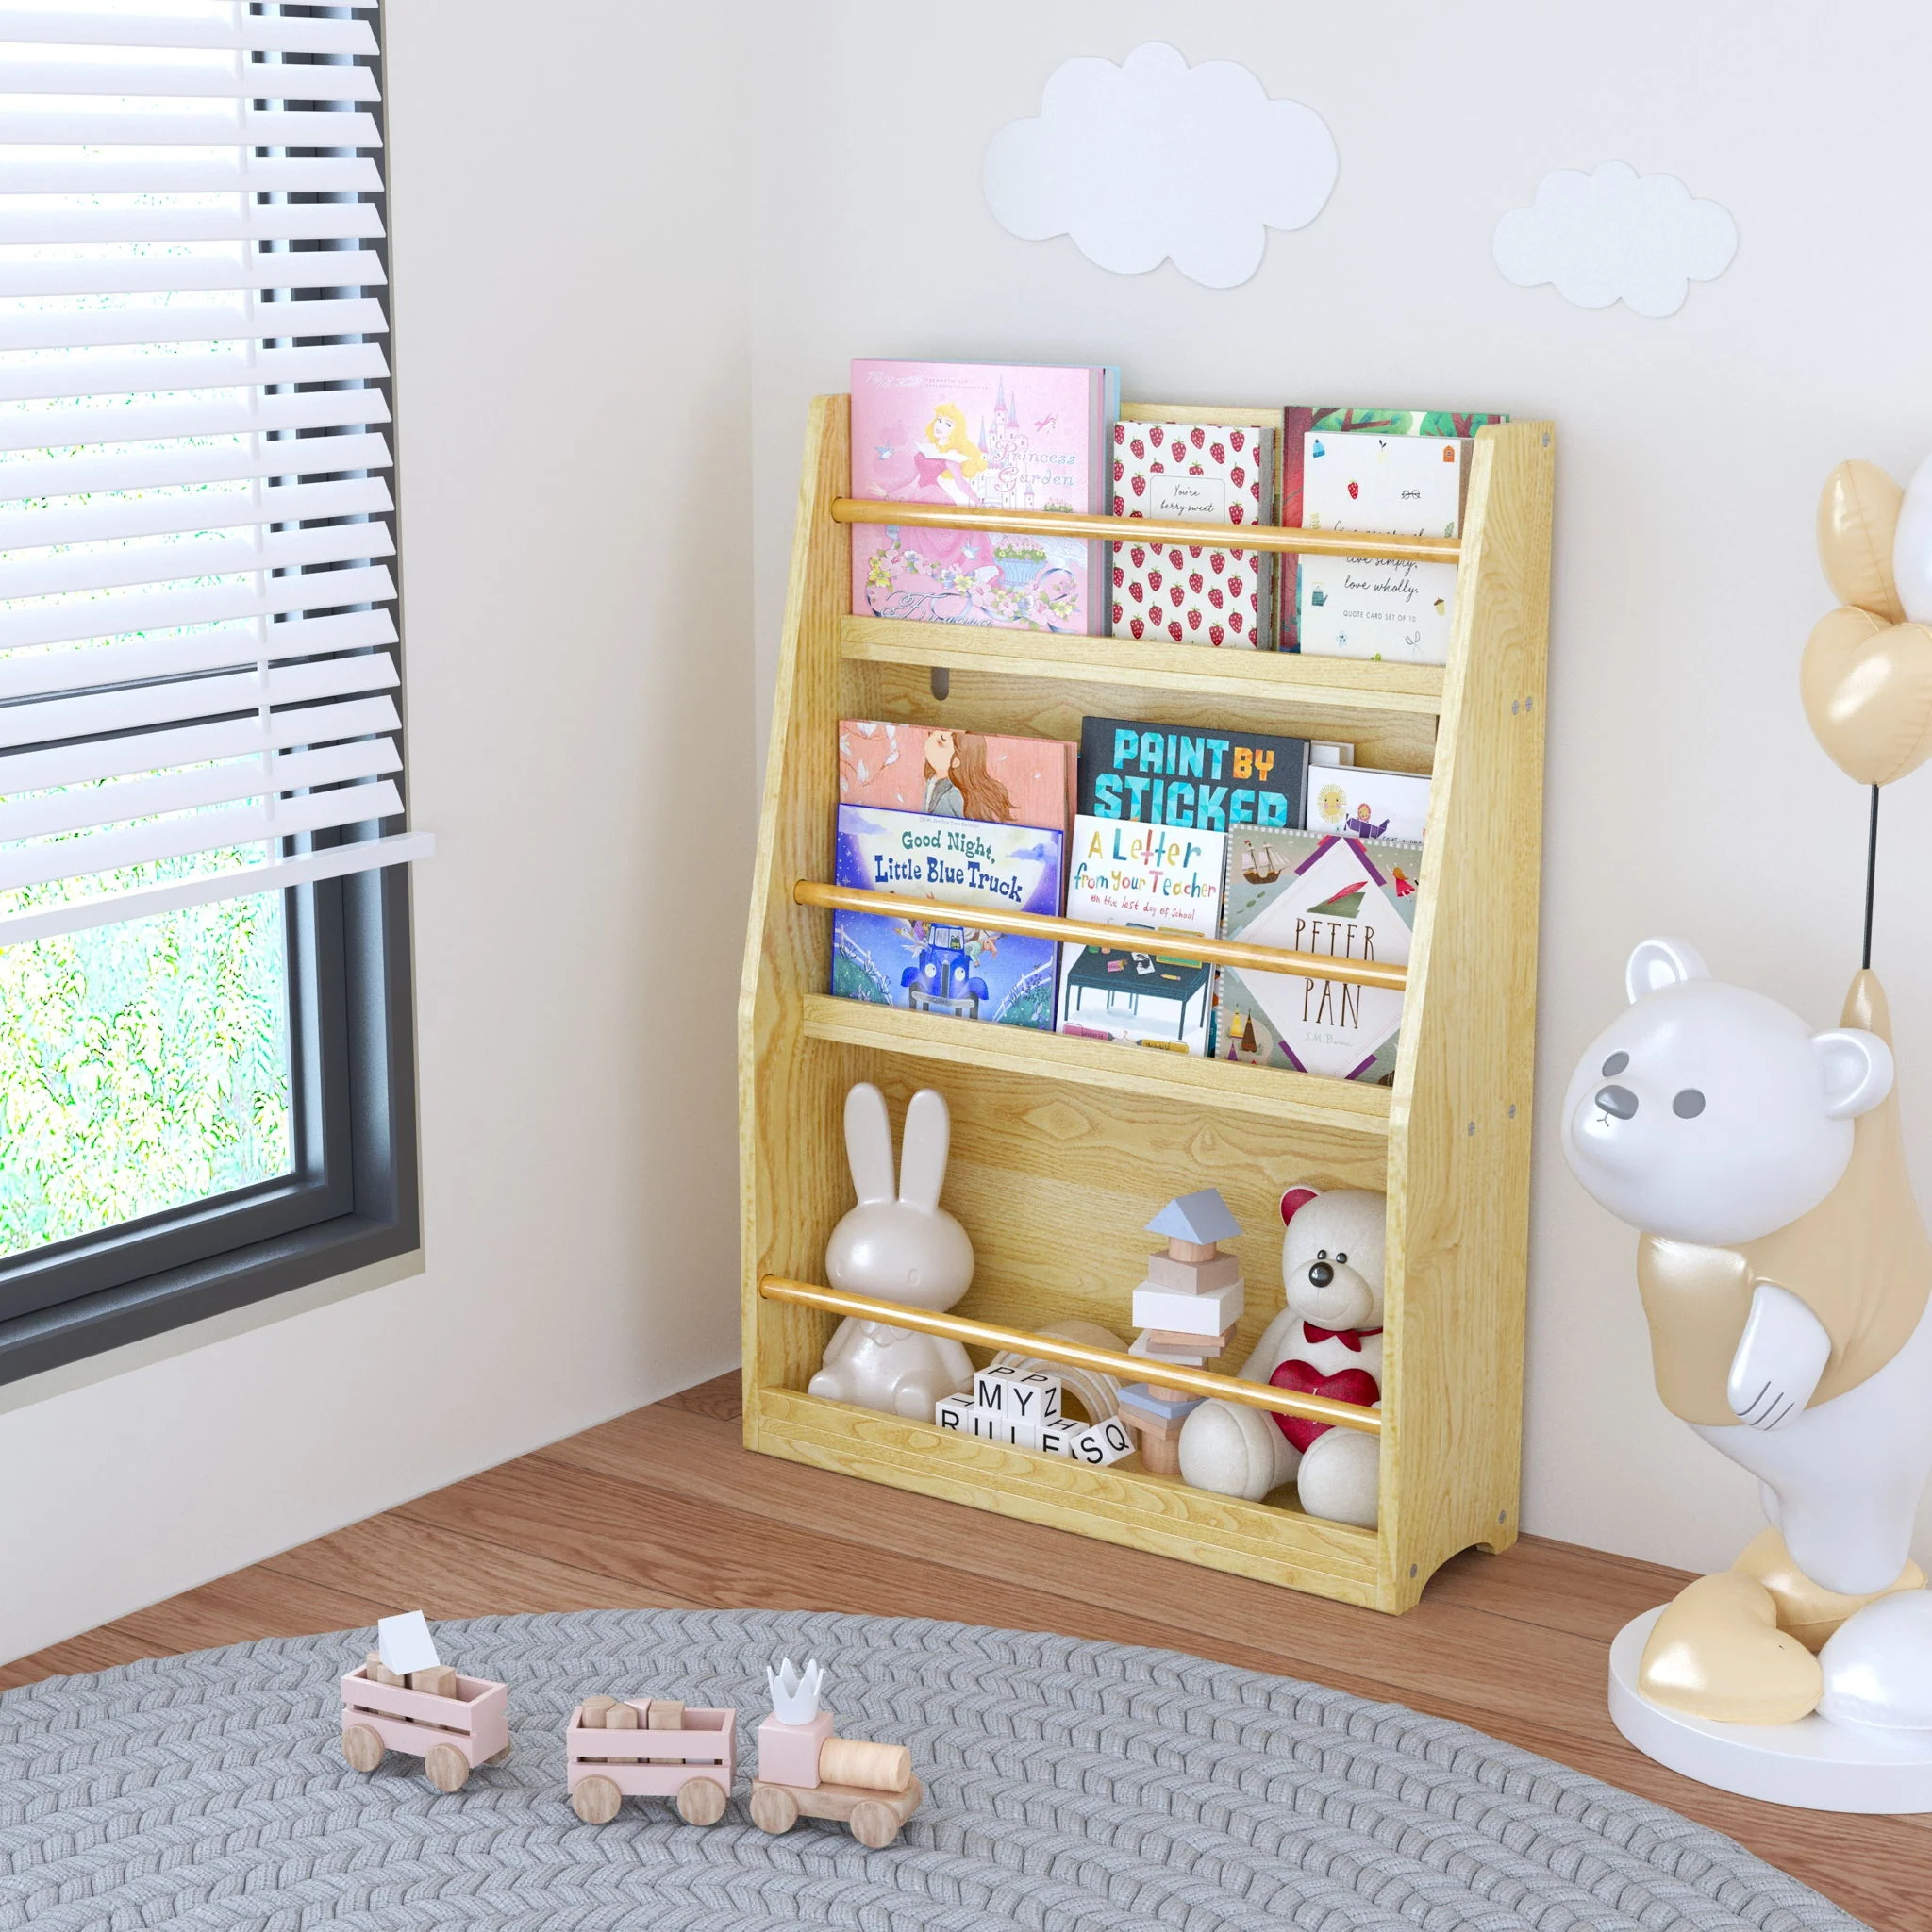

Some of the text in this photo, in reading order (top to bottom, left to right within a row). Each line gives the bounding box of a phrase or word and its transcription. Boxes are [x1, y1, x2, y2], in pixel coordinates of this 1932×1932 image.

[993, 440, 1076, 465] Princess
[994, 467, 1074, 492] Garden
[1174, 484, 1200, 497] You're
[1160, 500, 1215, 516] berry sweet
[1345, 575, 1371, 590] love
[1343, 609, 1364, 618] QUOTE
[1366, 611, 1383, 620] CARD
[1113, 728, 1274, 781] PAINT BY
[901, 830, 996, 865] Good Night,
[1088, 828, 1202, 868] A Letter
[874, 854, 1023, 903] Little Blue Truck
[1074, 862, 1108, 890] from
[1149, 870, 1217, 898] Teacher
[1104, 895, 1118, 908] the
[1121, 896, 1139, 910] last
[1159, 908, 1170, 918] of
[1295, 918, 1374, 961] PETER
[1303, 978, 1361, 1029] PAN
